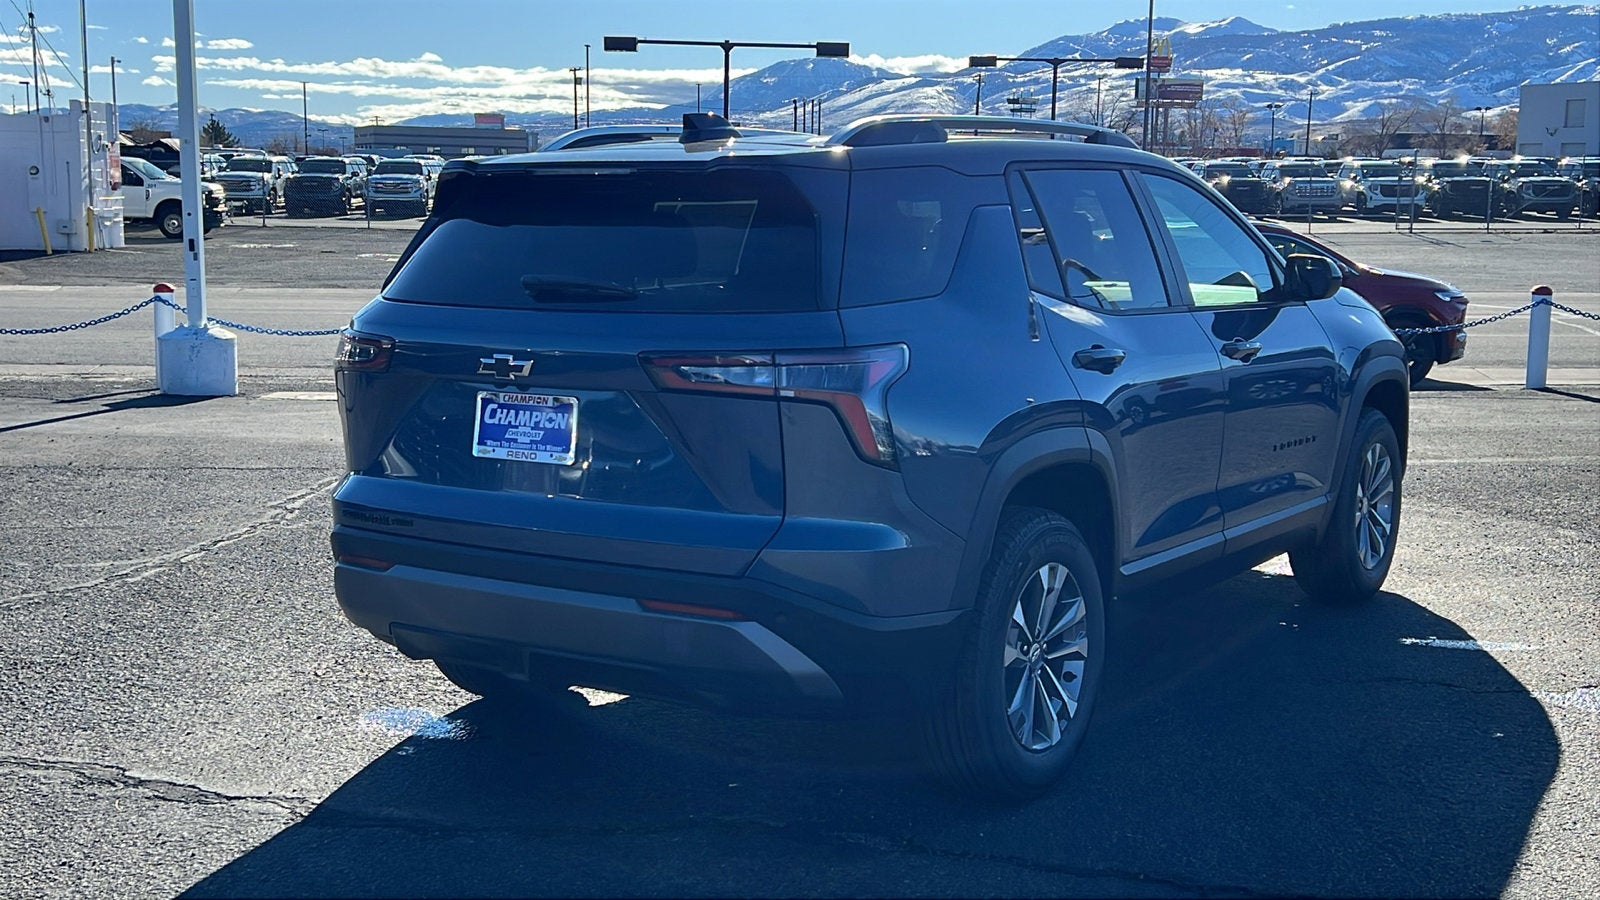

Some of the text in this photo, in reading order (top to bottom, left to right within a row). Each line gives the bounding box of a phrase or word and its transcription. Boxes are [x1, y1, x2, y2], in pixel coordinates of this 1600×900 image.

[503, 394, 549, 405] CHAMPION
[484, 403, 569, 429] CHAMPION
[507, 431, 542, 439] CHEVROLET
[506, 450, 537, 460] RENO
